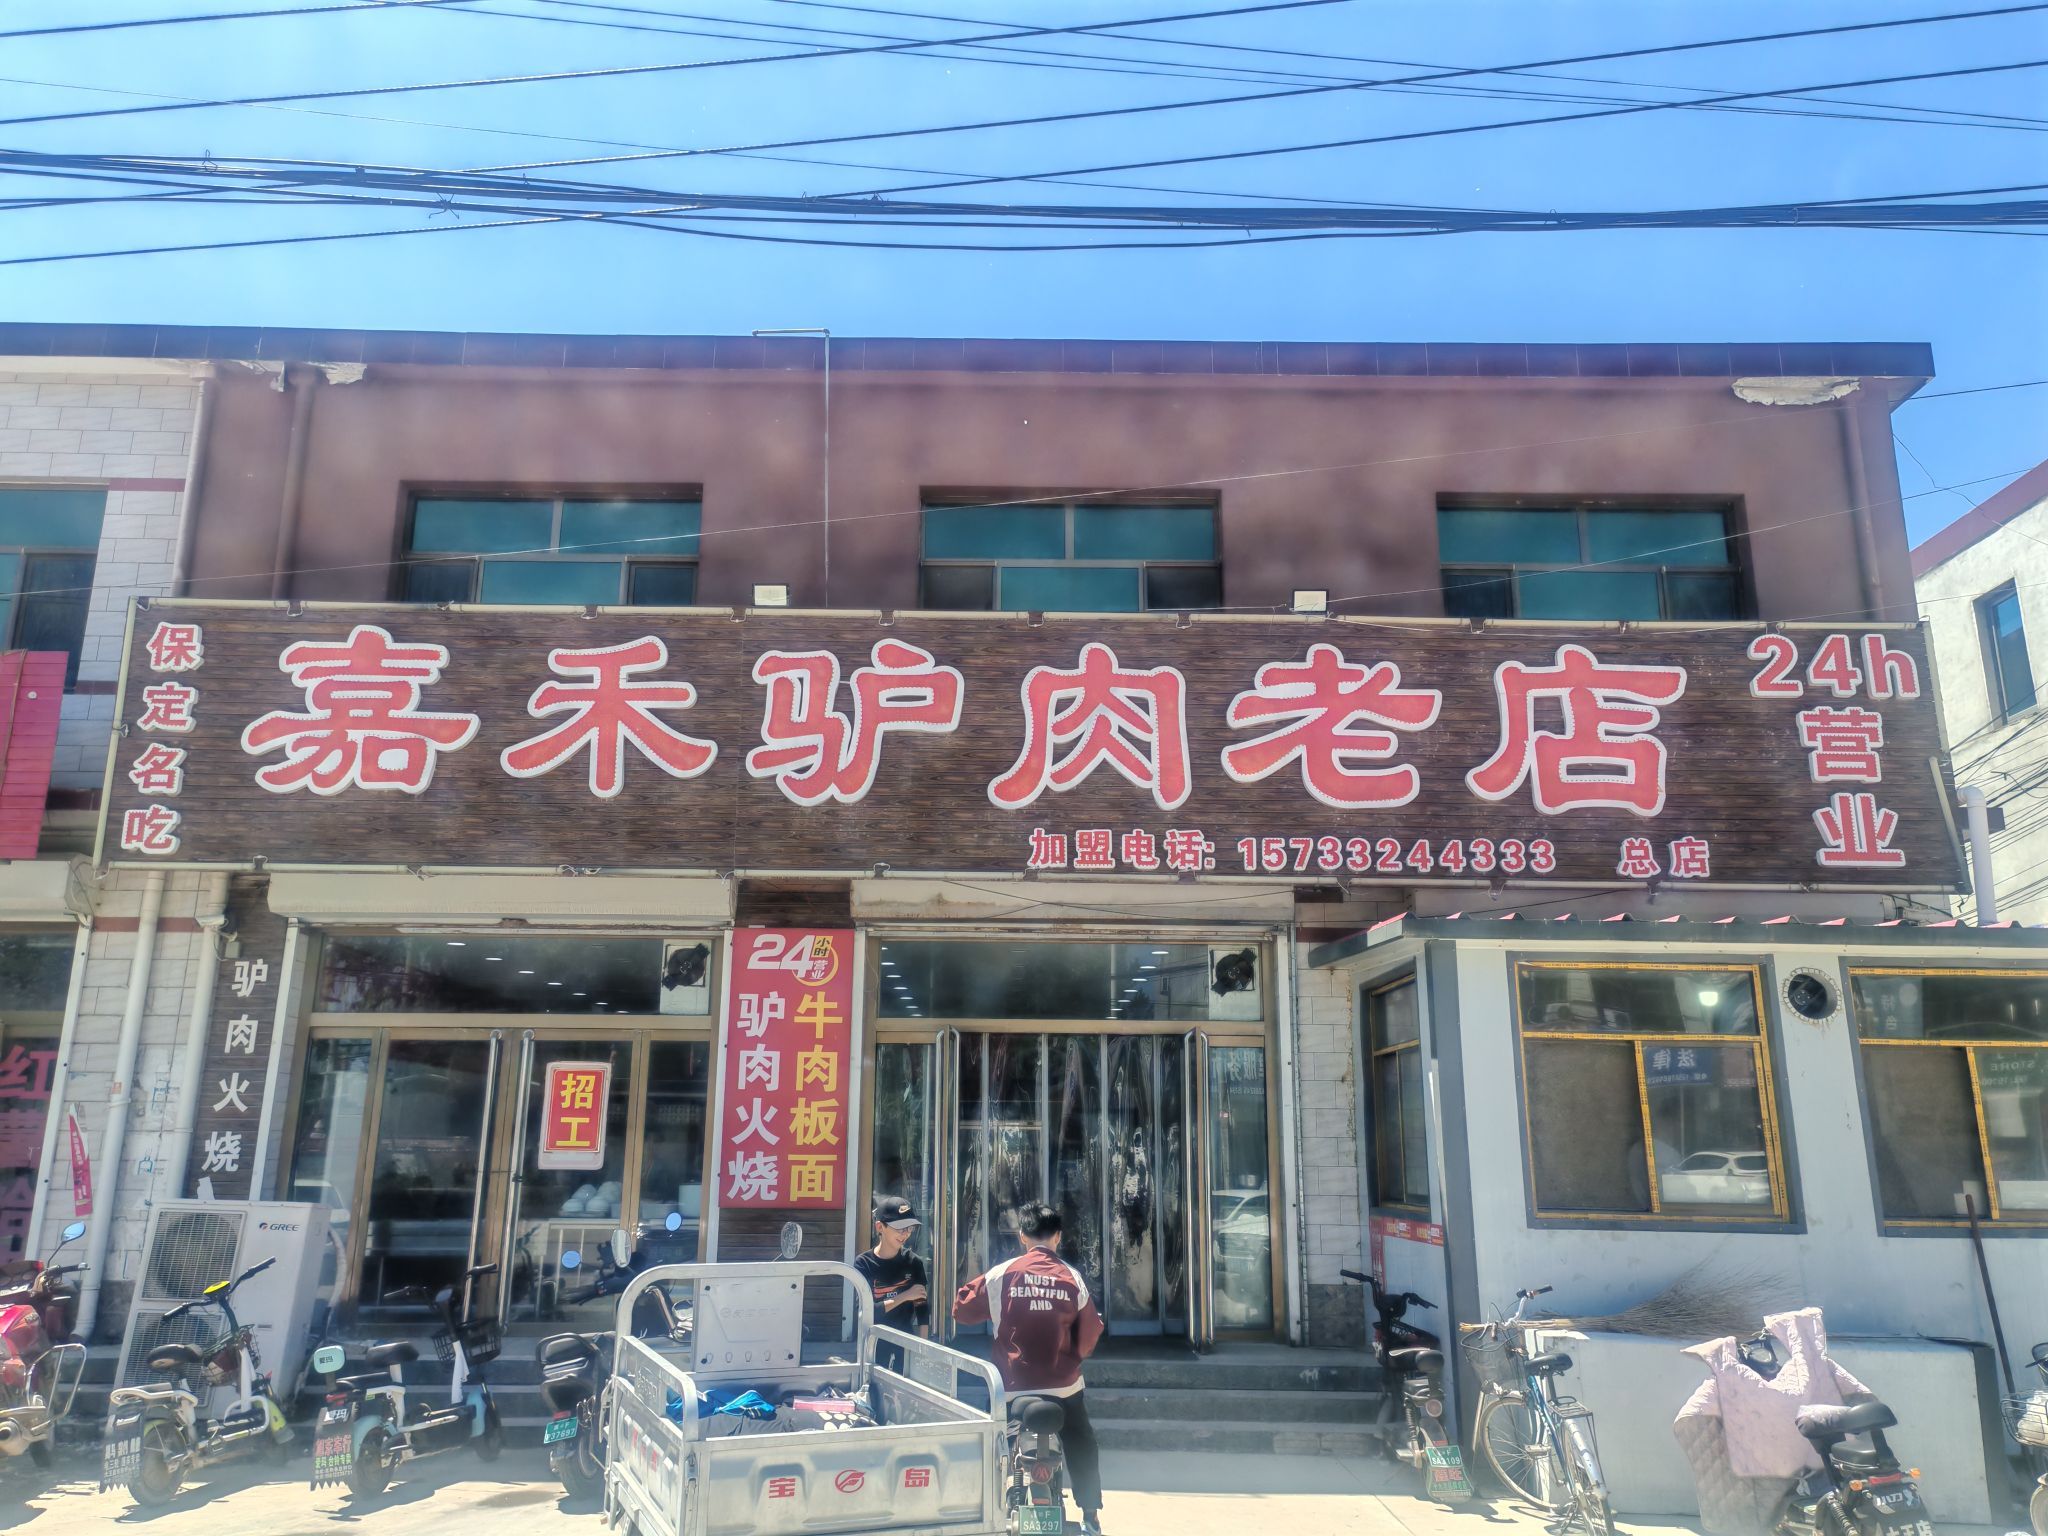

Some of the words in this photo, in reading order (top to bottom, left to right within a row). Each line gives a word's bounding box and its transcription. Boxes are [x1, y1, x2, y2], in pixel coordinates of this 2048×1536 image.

[1747, 633, 1920, 700] 24h
[121, 621, 204, 855] 保定名吃
[240, 624, 1687, 818] 嘉禾驴肉老店
[1796, 705, 1906, 868] 营业
[1237, 835, 1557, 874] 15733244333
[1616, 836, 1712, 879] 总店
[747, 933, 815, 978] 24
[813, 937, 831, 957] 小时
[201, 958, 269, 1173] 驴肉火烧
[555, 1073, 596, 1148] 招工
[727, 990, 786, 1202] 驴肉火烧
[787, 991, 844, 1202] 牛肉板面
[269, 1223, 300, 1232] GREE
[1010, 1286, 1071, 1302] BEAUTIFUL
[1024, 1273, 1057, 1287] MUST
[1029, 1300, 1053, 1311] AND
[904, 1468, 931, 1488] 岛
[1023, 1520, 1059, 1531] SA3297
